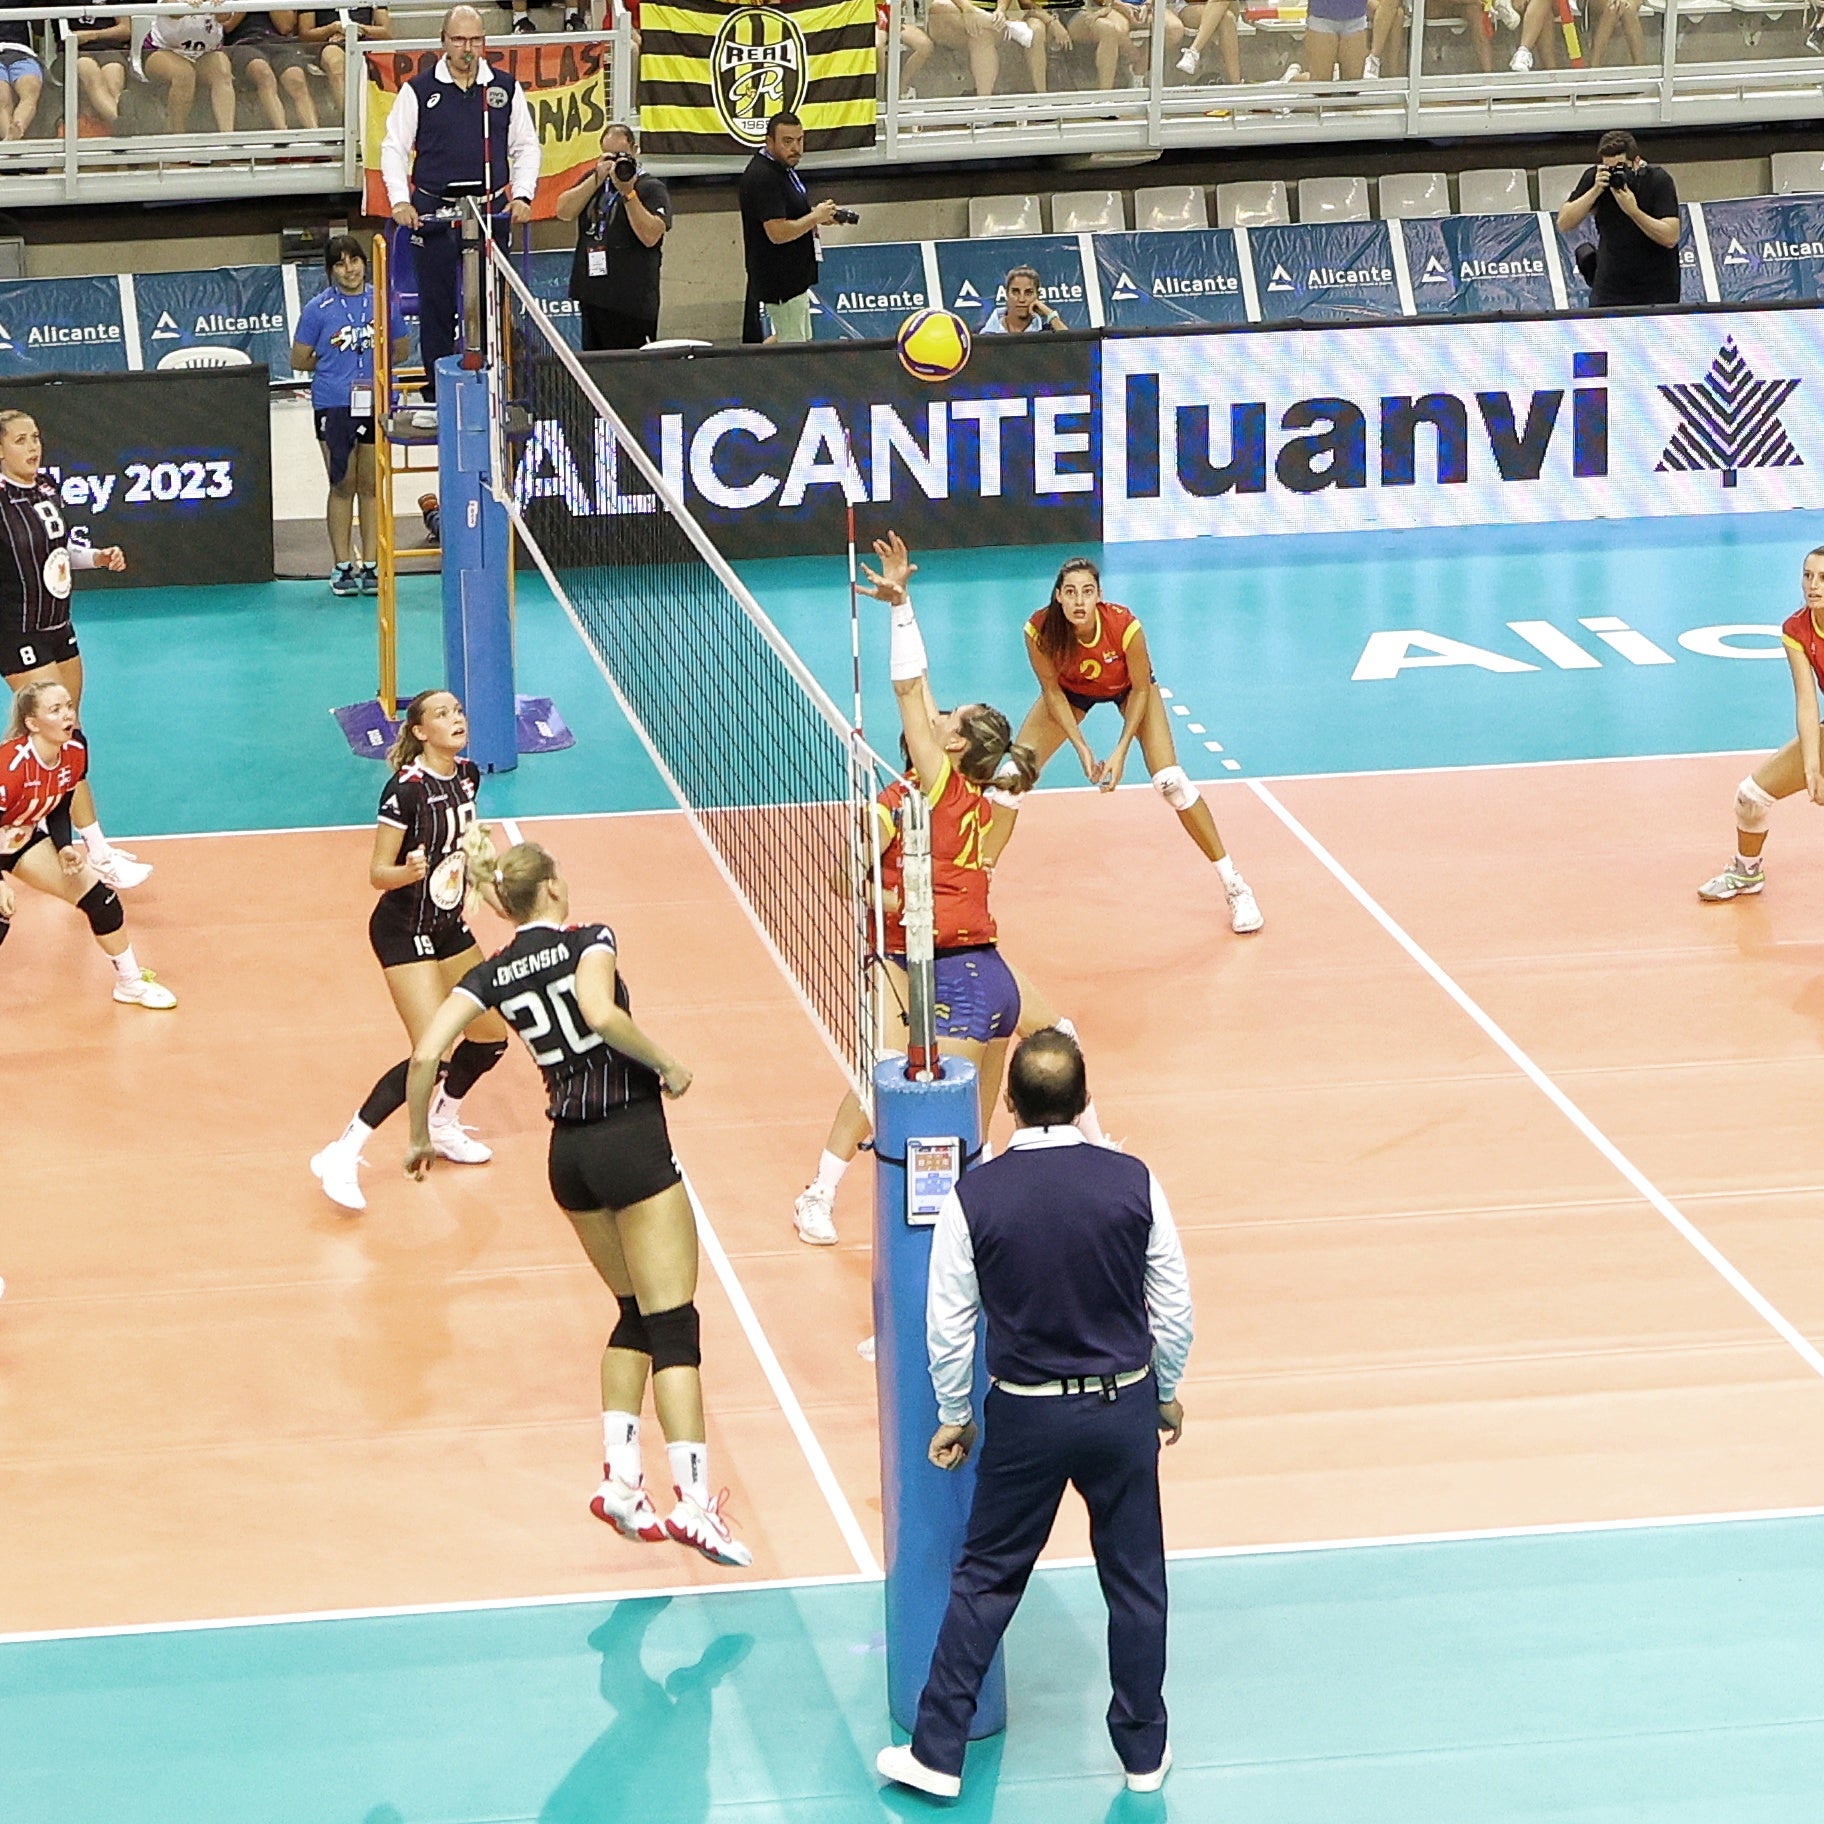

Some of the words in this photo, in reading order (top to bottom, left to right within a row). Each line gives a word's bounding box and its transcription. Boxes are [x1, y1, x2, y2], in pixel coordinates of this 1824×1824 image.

[725, 40, 793, 66] REAL
[393, 50, 437, 87] PO
[1307, 266, 1393, 286] Alicante
[1460, 258, 1544, 278] Alicante
[996, 282, 1083, 301] Aante
[1152, 276, 1239, 295] Alicante
[836, 291, 925, 310] Alicante
[27, 322, 120, 343] Alicante
[194, 310, 284, 332] Alicante
[1124, 350, 1609, 499] luanvi
[514, 393, 1096, 517] ALICANTE
[124, 461, 234, 502] 2023
[34, 500, 64, 541] 8
[19, 645, 37, 667] 8
[413, 933, 436, 956] 19
[493, 942, 570, 987] ØRGENSEN
[499, 972, 606, 1067] 20
